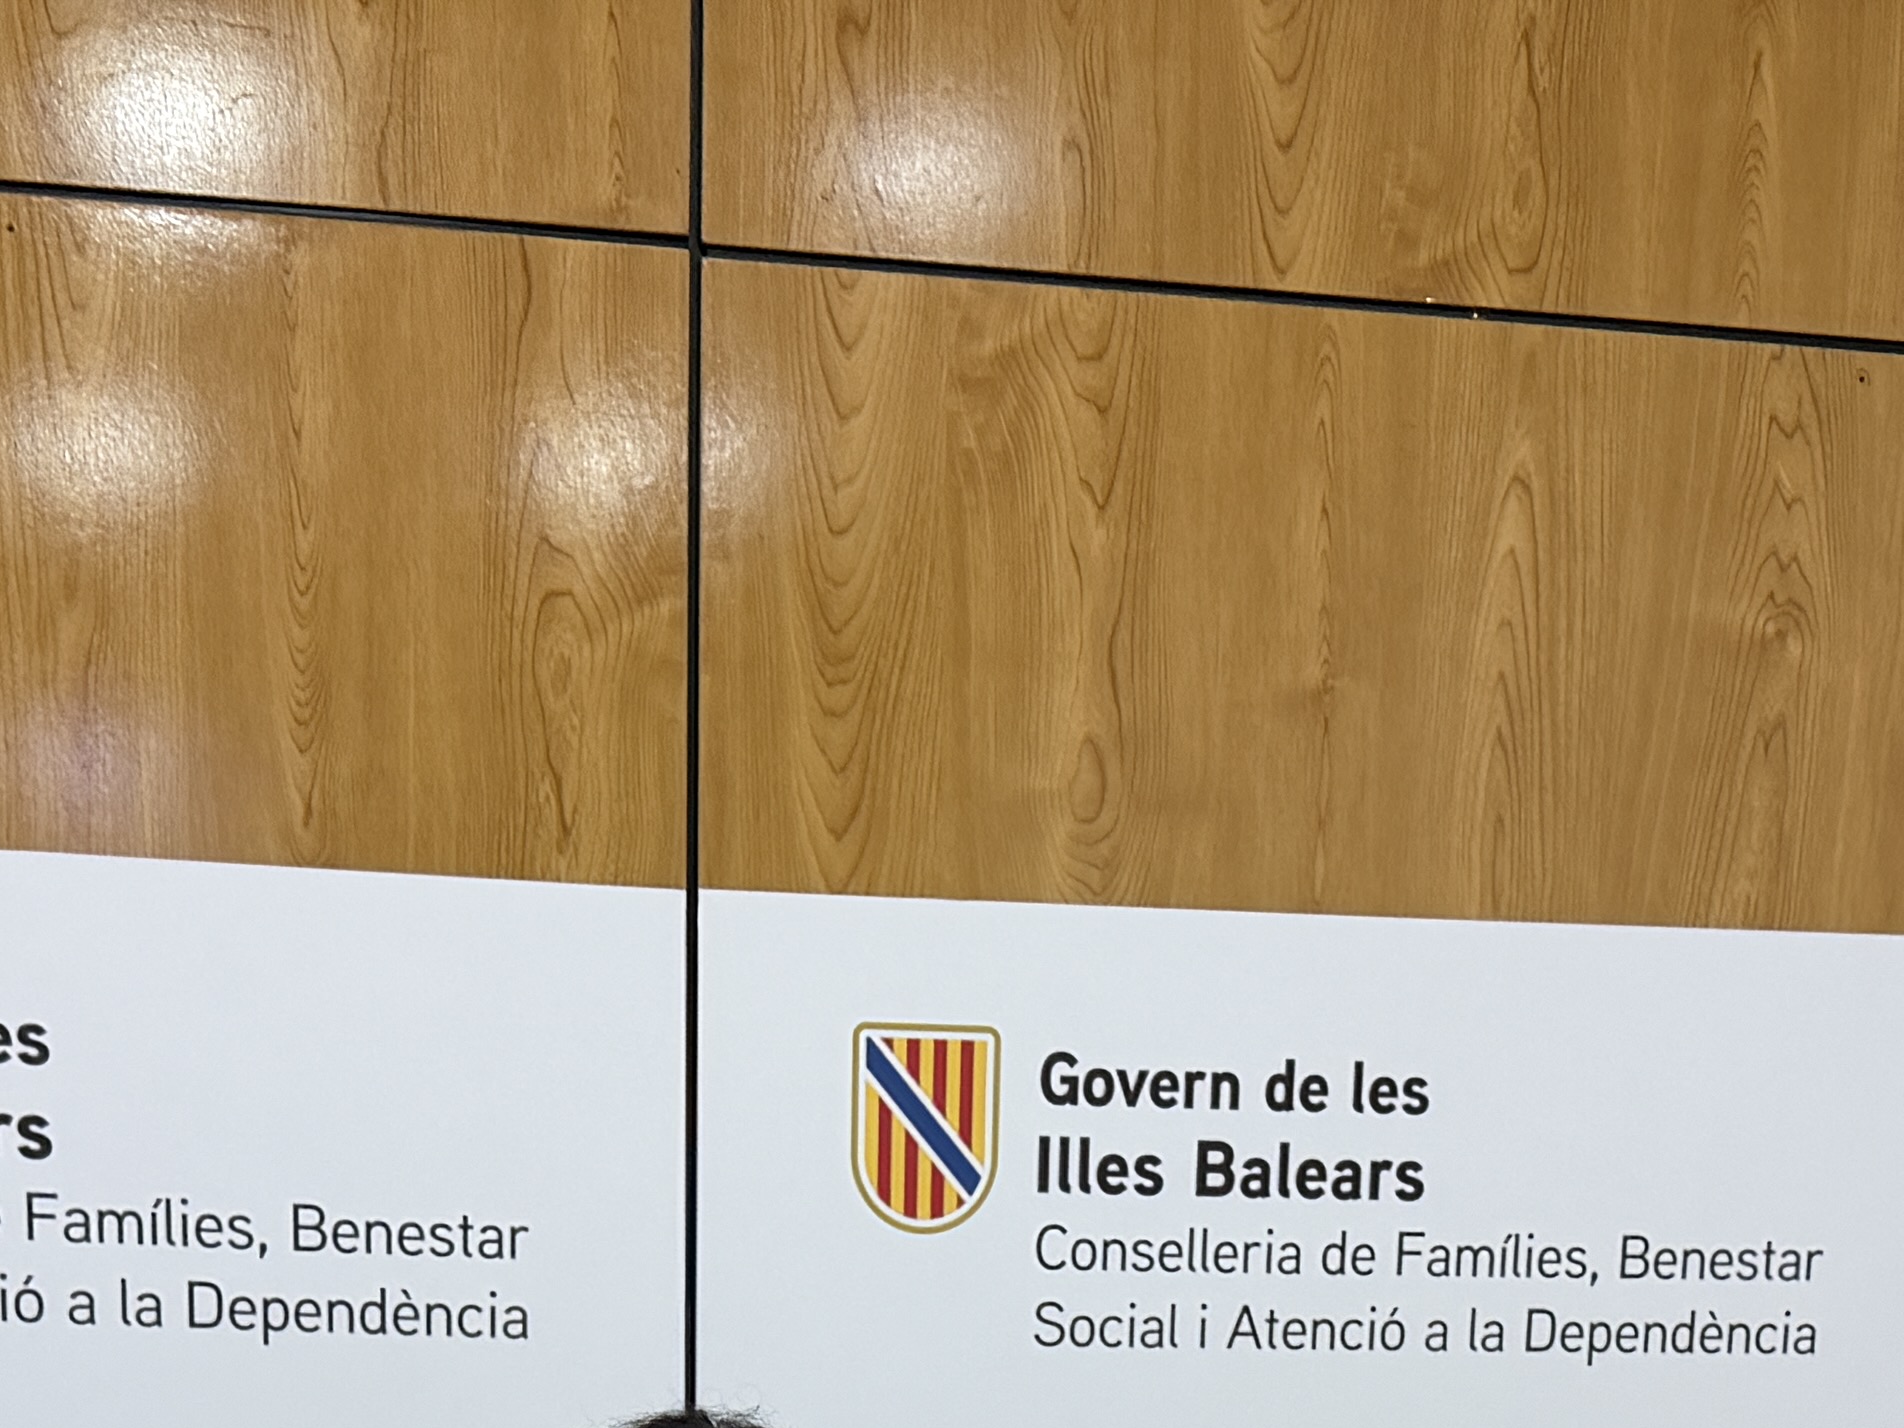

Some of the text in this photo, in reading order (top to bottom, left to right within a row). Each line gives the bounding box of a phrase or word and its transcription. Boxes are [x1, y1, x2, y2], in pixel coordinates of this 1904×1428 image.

[1040, 1051, 1429, 1115] Govern de les
[1037, 1136, 1424, 1202] Illes Balears
[26, 1192, 267, 1259] Famílies,
[293, 1203, 529, 1259] Benestar
[1036, 1224, 1823, 1287] Conselleria de Famílies, Benestar
[69, 1290, 96, 1325] a
[121, 1278, 162, 1328] la
[188, 1280, 528, 1346] Dependència
[1034, 1301, 1816, 1366] Social i Atenció a la Dependència
